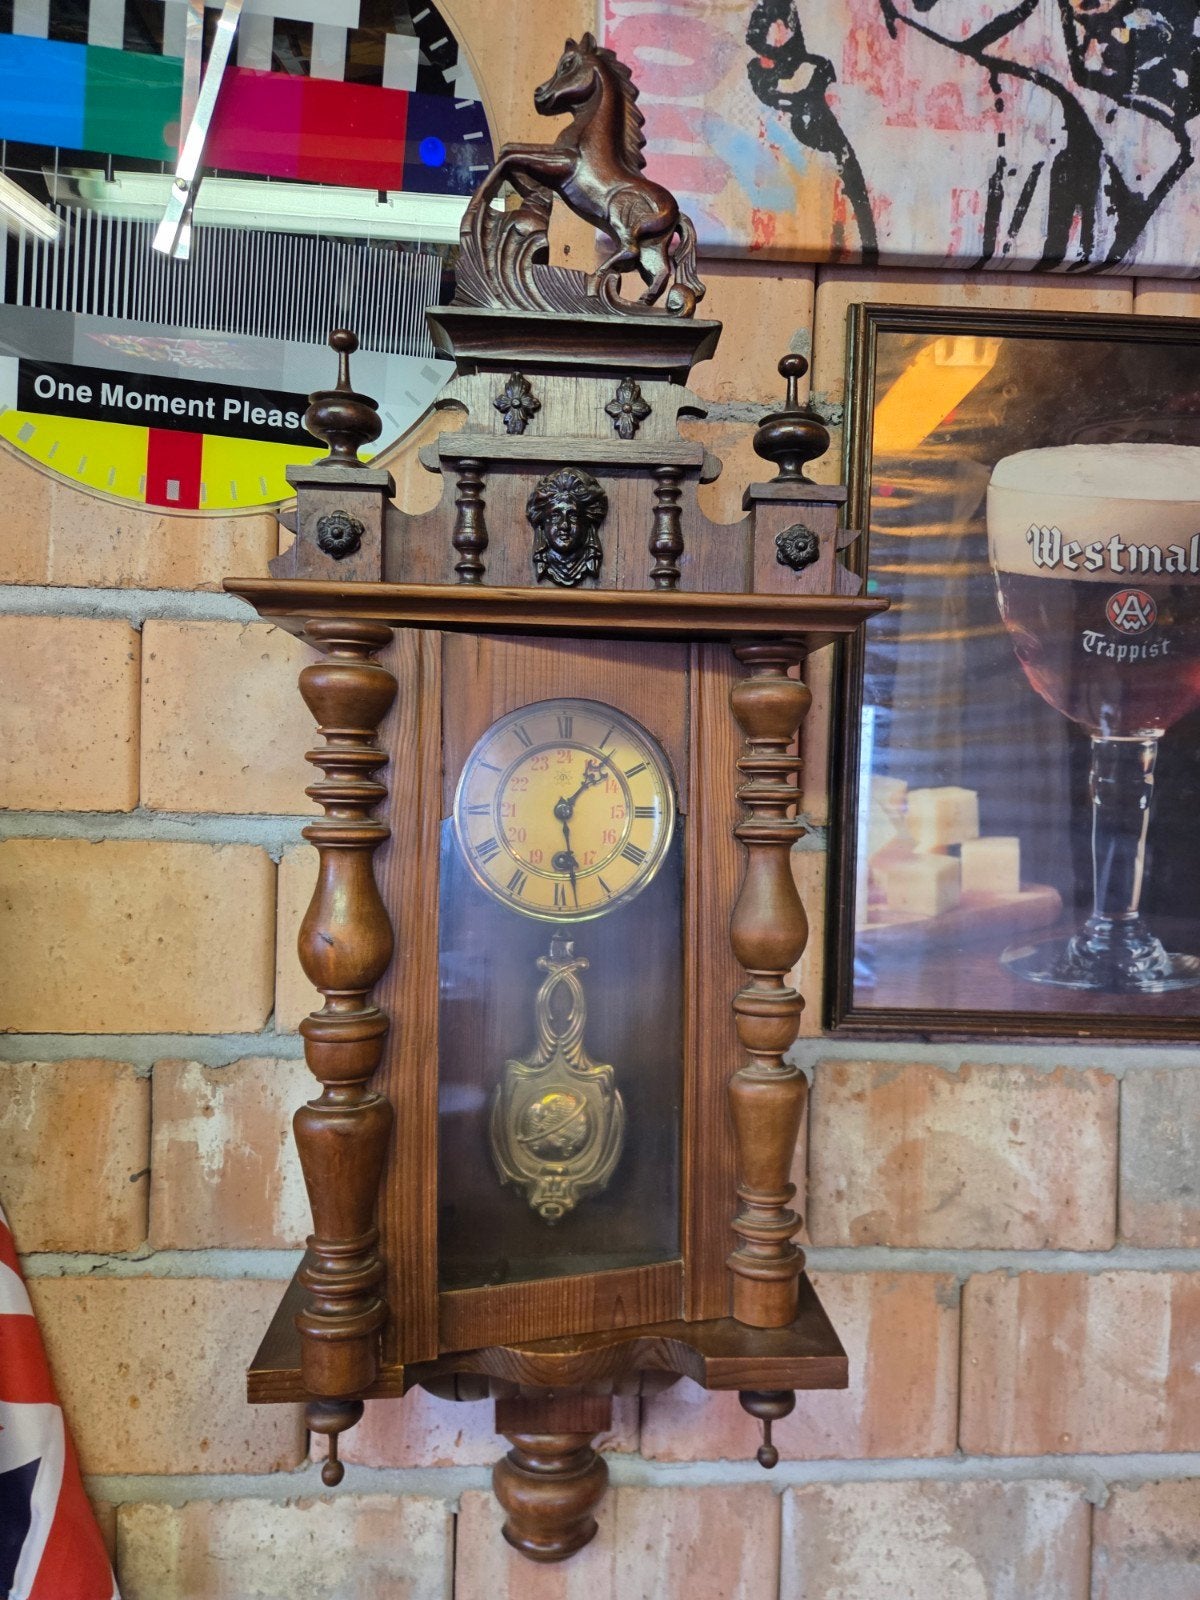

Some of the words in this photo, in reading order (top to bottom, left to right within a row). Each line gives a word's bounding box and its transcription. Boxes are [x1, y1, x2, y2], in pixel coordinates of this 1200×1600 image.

[34, 374, 92, 403] One
[101, 382, 215, 420] Moment
[1082, 630, 1171, 663] Trappist
[531, 755, 549, 771] 23
[556, 749, 574, 764] 24
[511, 776, 529, 792] 22
[604, 779, 620, 794] 14
[501, 802, 517, 817] 21
[610, 804, 625, 819] 15
[508, 827, 527, 843] 20
[602, 829, 617, 845] 16
[529, 849, 544, 864] 19
[583, 850, 597, 865] 17
